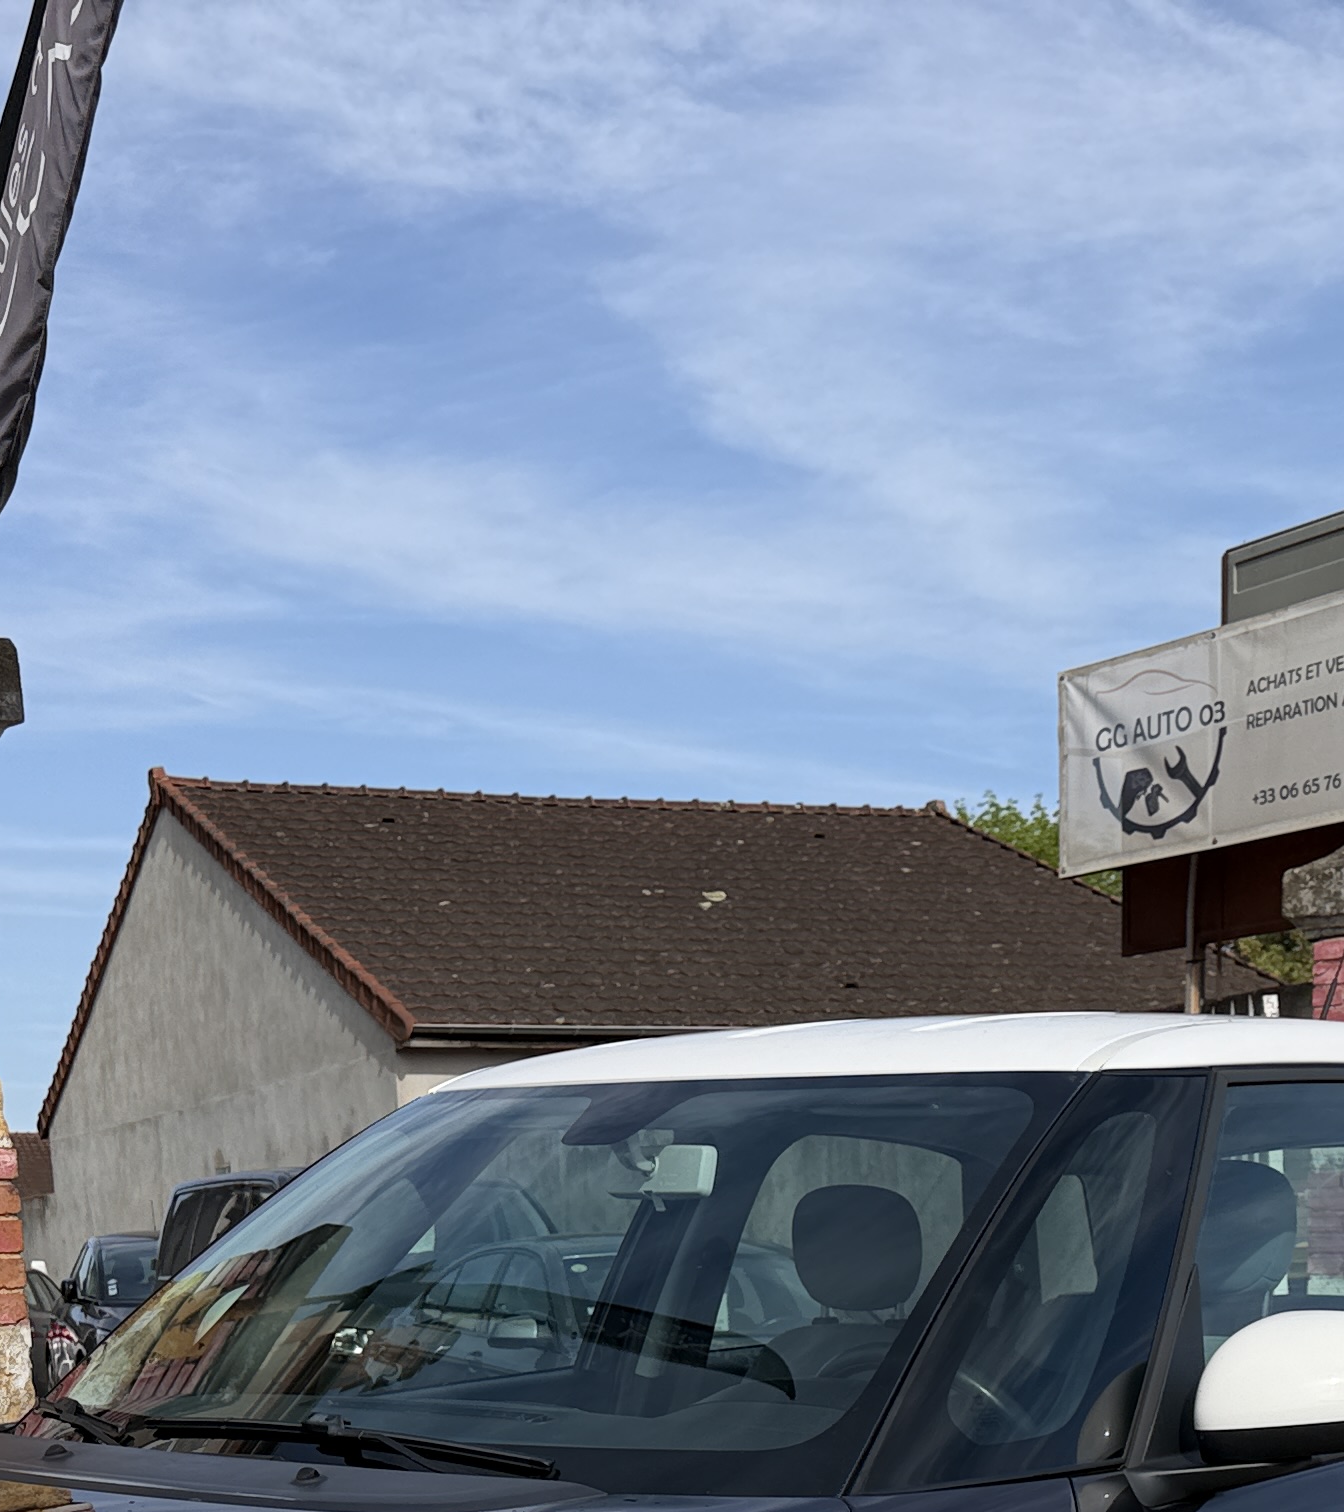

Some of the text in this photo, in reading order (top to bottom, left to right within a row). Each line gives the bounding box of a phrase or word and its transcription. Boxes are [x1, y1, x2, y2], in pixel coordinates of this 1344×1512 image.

[1246, 667, 1302, 697] ACHATS
[1305, 661, 1323, 681] ET
[1096, 700, 1226, 752] GG AUTO 03
[1246, 692, 1338, 730] REPARATION
[1252, 788, 1275, 806] +33
[1279, 782, 1299, 800] 06
[1302, 777, 1320, 796] 65
[1323, 773, 1342, 791] 76
